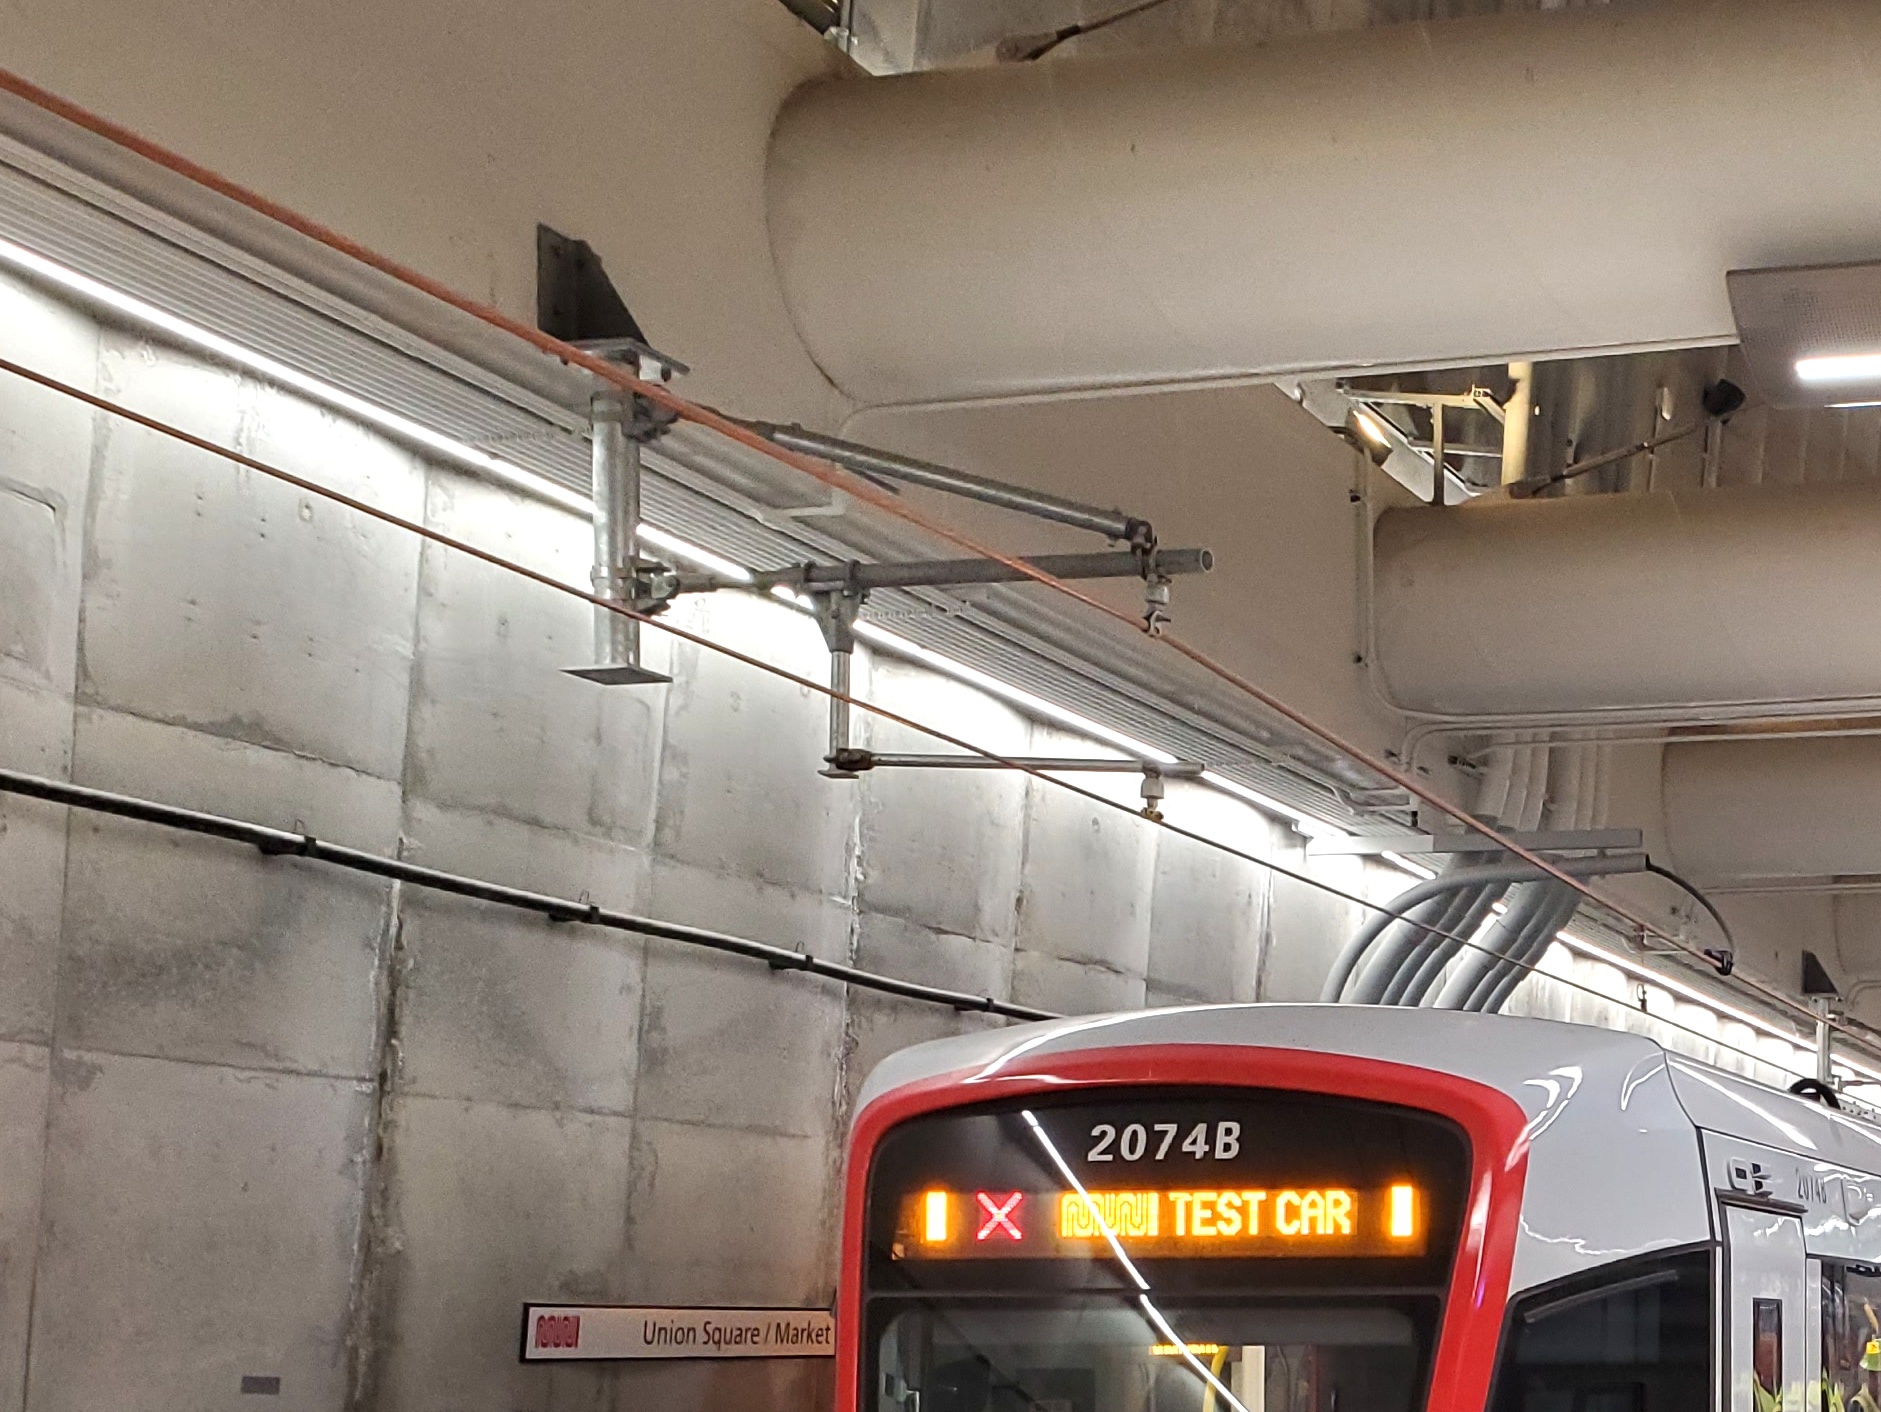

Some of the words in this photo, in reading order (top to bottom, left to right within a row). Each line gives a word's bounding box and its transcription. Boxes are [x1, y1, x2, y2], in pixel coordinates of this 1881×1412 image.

[1087, 1121, 1241, 1162] 2074B
[1169, 1192, 1267, 1237] TEST
[1275, 1191, 1351, 1236] CAR
[643, 1320, 697, 1345] Union
[702, 1321, 761, 1350] Square
[764, 1322, 771, 1345] /
[775, 1321, 832, 1345] Market
